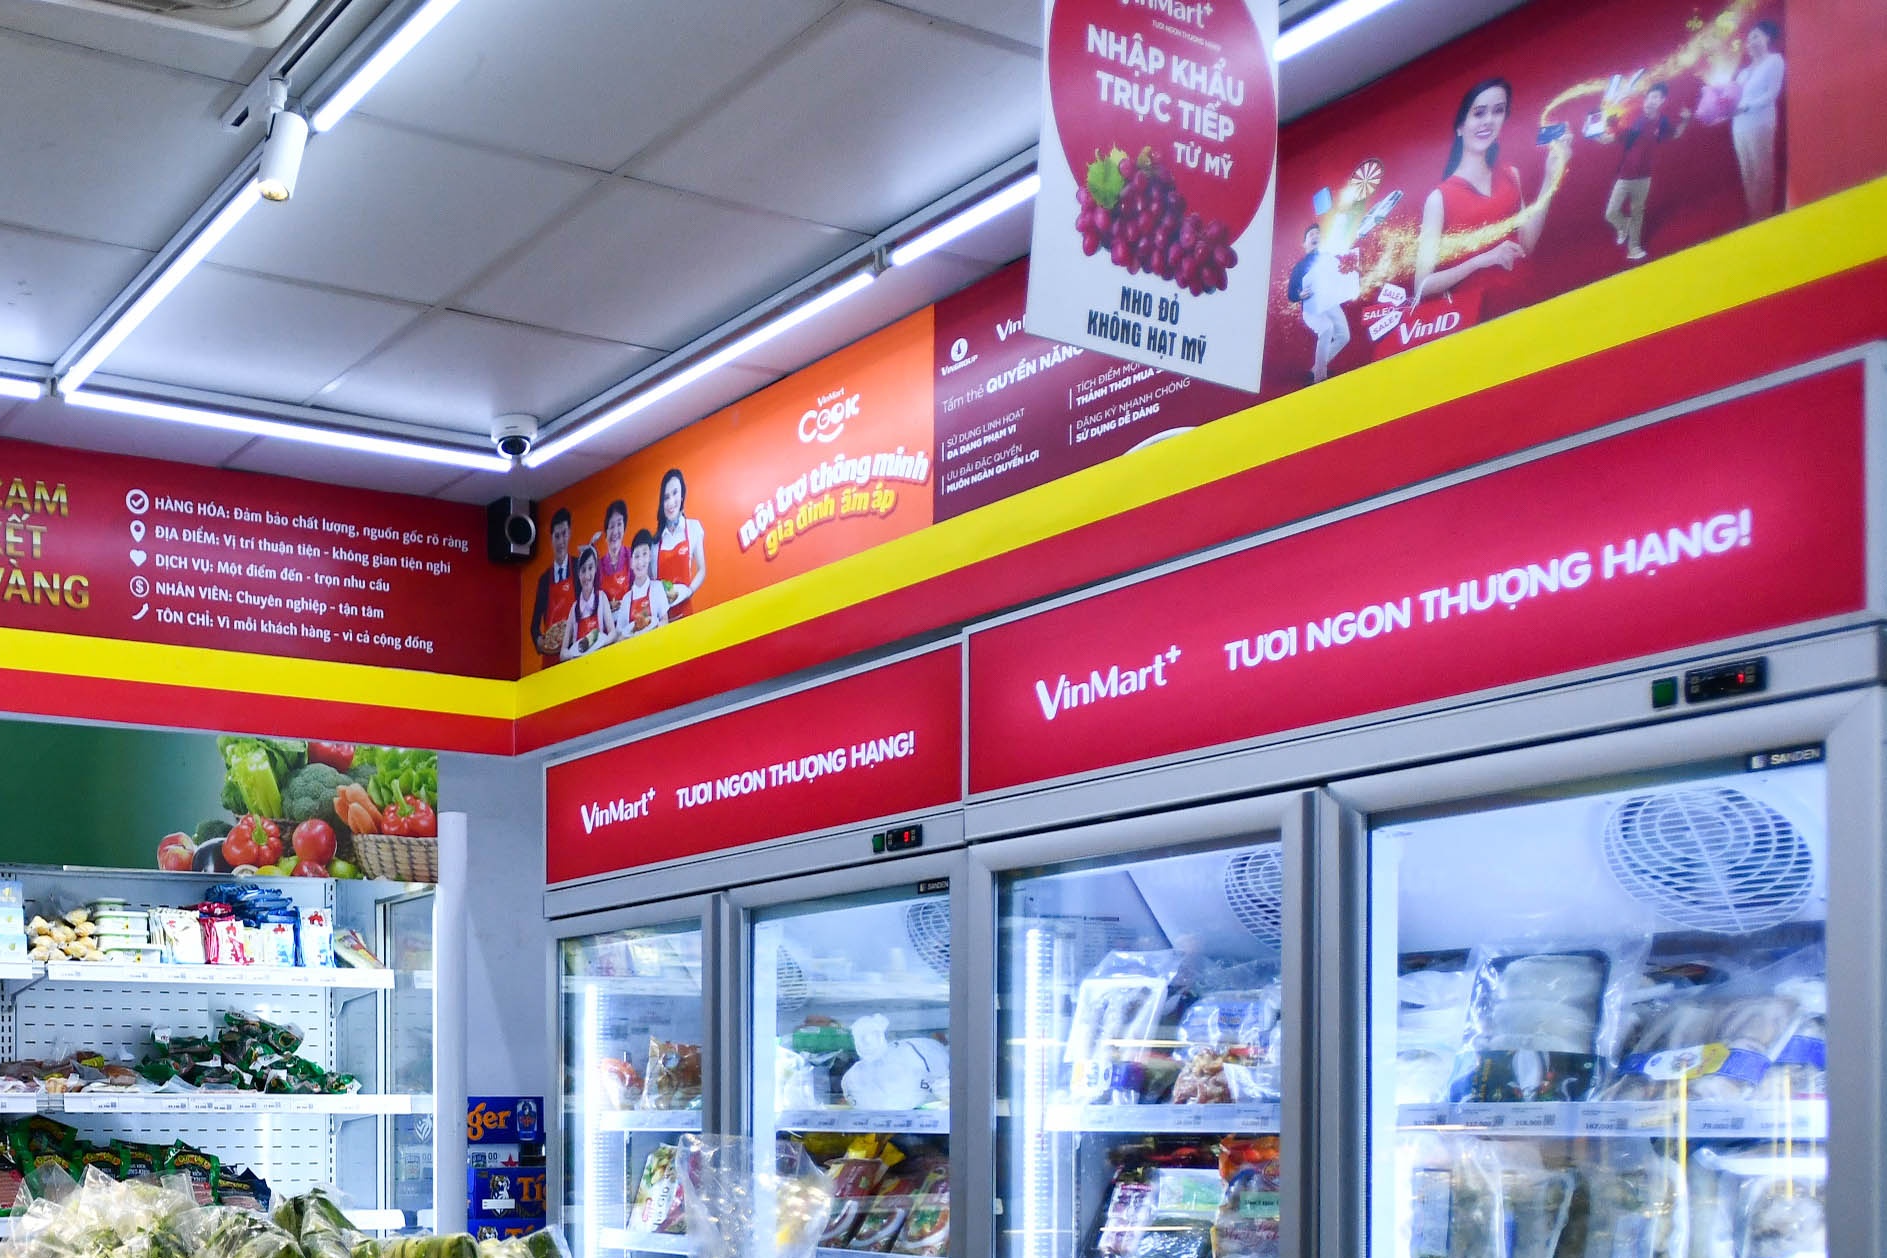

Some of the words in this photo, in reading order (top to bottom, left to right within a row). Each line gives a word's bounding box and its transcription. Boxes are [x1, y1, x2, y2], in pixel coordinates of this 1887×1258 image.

[1087, 23, 1165, 77] NHẬP
[1171, 57, 1244, 107] KHẨU
[1096, 70, 1172, 122] TRỰC
[1178, 100, 1235, 142] TIẾP
[1174, 141, 1201, 169] TỪ
[1205, 153, 1233, 179] MỸ
[1120, 285, 1153, 318] NHO
[1158, 293, 1180, 326] ĐỎ
[1086, 308, 1142, 348] KHÔNG
[1147, 327, 1176, 361] HẠT
[1182, 333, 1207, 365] MỸ
[1399, 312, 1460, 345] VinID
[967, 384, 984, 402] thẻ
[986, 358, 1037, 395] QUYỀN
[1076, 379, 1097, 393] TÍCH
[1098, 367, 1121, 385] ĐIỂM
[1132, 367, 1154, 384] MUA
[959, 425, 982, 443] DỤNG
[983, 417, 1002, 433] LINH
[1003, 407, 1025, 425] HOẠT
[1076, 411, 1103, 430] ĐĂNG
[1119, 392, 1153, 413] NHANH
[1090, 418, 1117, 438] DỤNG
[1118, 410, 1131, 427] DỄ
[1132, 402, 1160, 421] DÀNG
[960, 439, 983, 456] DẠNG
[983, 430, 1007, 446] PHẠM
[1006, 423, 1017, 435] VI
[975, 455, 992, 471] ĐẶC
[993, 443, 1023, 461] QUYỀN
[971, 466, 995, 484] NGÀN
[995, 454, 1024, 474] QUYỀN
[1025, 449, 1040, 465] LỢI
[739, 500, 775, 547] nội
[776, 473, 808, 513] trợ
[810, 452, 871, 494] thông
[872, 445, 929, 481] minh
[154, 496, 194, 515] HÀNG
[197, 501, 230, 519] HÓA:
[234, 506, 262, 524] Đảm
[265, 511, 288, 527] bảo
[292, 514, 319, 530] chất
[322, 519, 359, 538] lượng,
[363, 525, 400, 542] nguồn
[402, 530, 423, 546] gốc
[426, 533, 440, 546] rõ
[442, 534, 469, 553] ràng
[765, 519, 795, 556] gia
[796, 494, 836, 530] đình
[840, 486, 870, 514] ấm
[871, 482, 896, 513] áp
[155, 525, 179, 542] ĐỊA
[182, 526, 220, 546] ĐIỂM:
[223, 533, 237, 551] Vị
[239, 536, 256, 551] trí
[258, 538, 294, 556] thuận
[297, 542, 321, 560] tiện
[331, 547, 369, 567] không
[372, 552, 398, 569] gian
[400, 555, 423, 571] tiện
[426, 560, 452, 576] nghi
[155, 554, 189, 572] DỊCH
[191, 557, 214, 576] VỤ:
[217, 560, 243, 578] Một
[246, 563, 277, 582] điểm
[280, 566, 303, 584] đến
[314, 571, 341, 589] trọn
[343, 575, 366, 590] nhu
[369, 576, 391, 593] cầu
[1224, 626, 1299, 672] TƯƠI
[1307, 598, 1410, 652] NGON
[1419, 552, 1591, 622] THƯỢNG
[1601, 508, 1753, 579] HẠNG!
[155, 581, 196, 598] NHÂN
[198, 585, 233, 604] VIÊN:
[236, 590, 283, 610] Chuyên
[285, 596, 327, 615] nghiệp
[338, 601, 359, 618] tận
[361, 603, 385, 620] tâm
[155, 607, 185, 625] TÔN
[187, 610, 214, 628] CHỈ:
[216, 615, 231, 629] Vì
[233, 616, 257, 633] mỗi
[260, 620, 298, 637] khách
[300, 624, 332, 643] hàng
[342, 629, 354, 643] vì
[356, 629, 370, 645] cả
[372, 632, 402, 650] cộng
[404, 635, 435, 654] đồng
[1034, 643, 1182, 721] VinMart+
[675, 780, 713, 810] TƯƠI
[716, 768, 766, 801] NGON
[769, 748, 847, 786] THƯỢNG
[851, 731, 915, 769] HẠNG!
[1770, 748, 1821, 765] SANDEN
[580, 787, 656, 835] VinMart+
